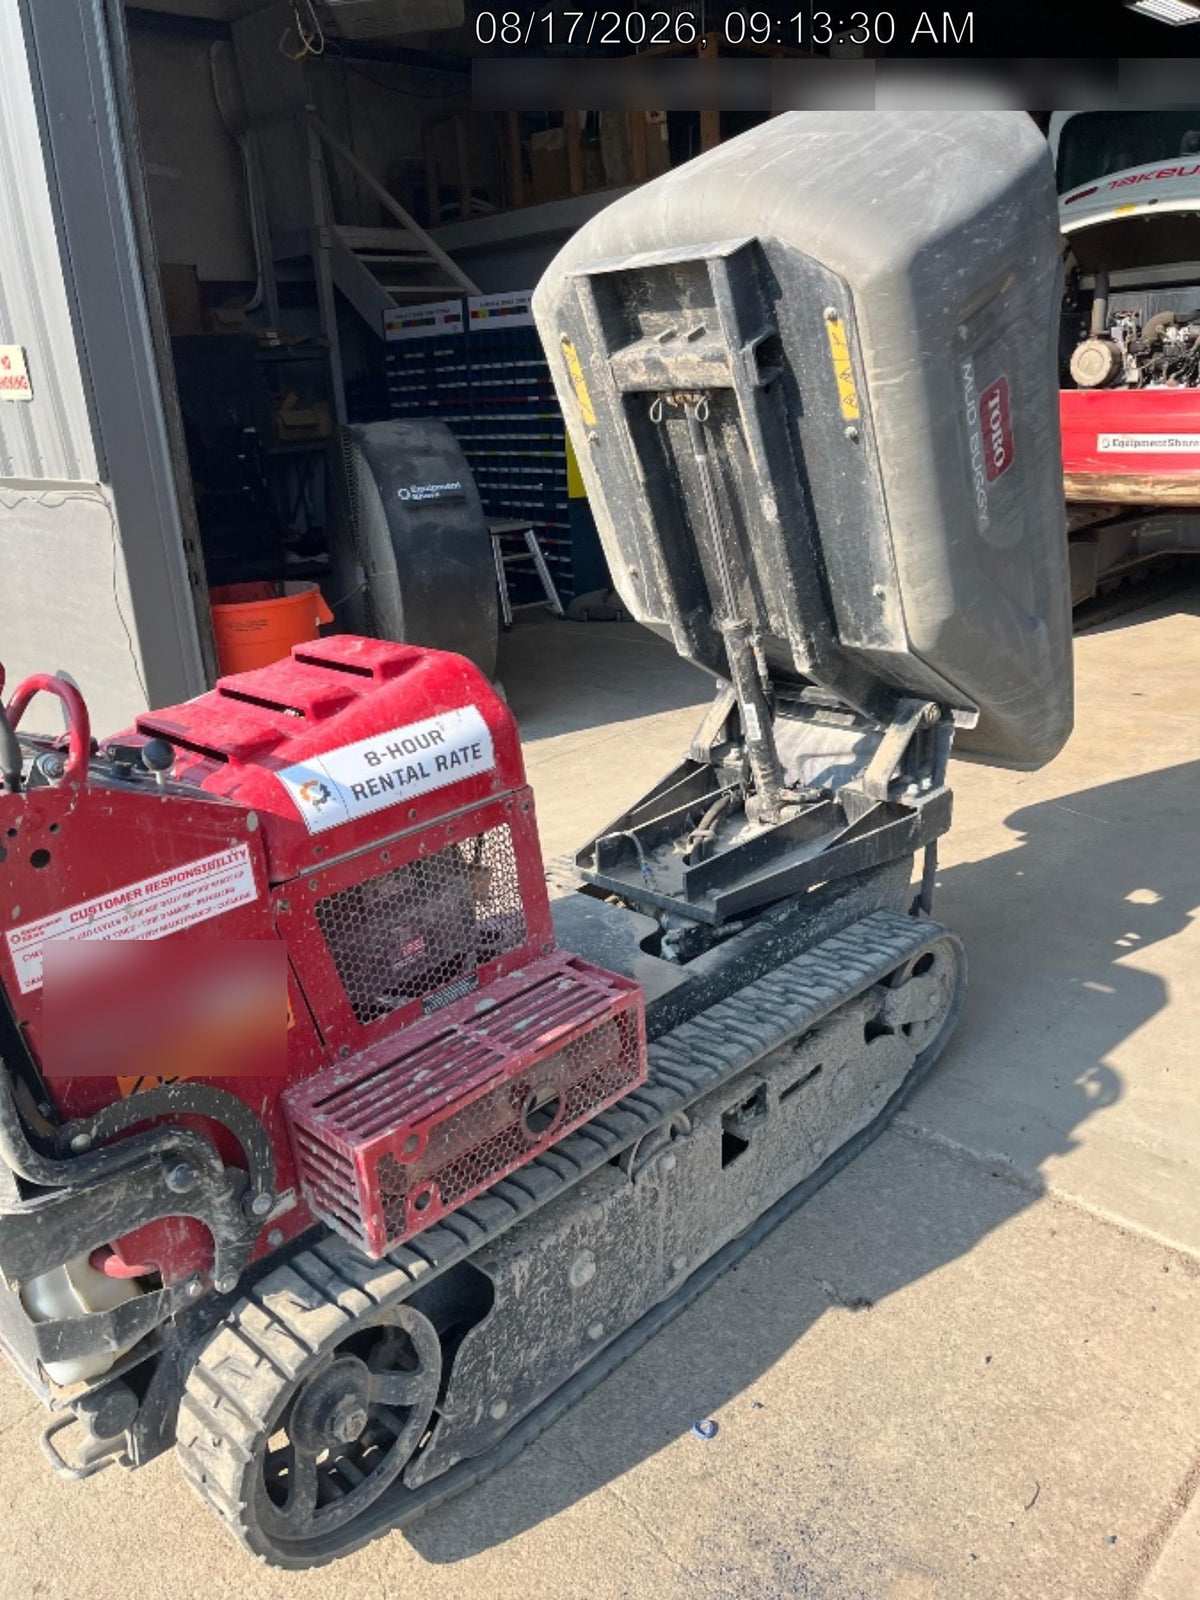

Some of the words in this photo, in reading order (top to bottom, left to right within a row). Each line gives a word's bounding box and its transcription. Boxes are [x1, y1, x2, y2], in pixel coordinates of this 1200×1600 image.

[962, 364, 977, 426] MUD
[989, 388, 1006, 468] TORO
[970, 432, 990, 522] BUGGY
[350, 762, 431, 801] RENTAL
[435, 742, 483, 772] RATE
[363, 729, 446, 767] 8-HOUR
[70, 888, 143, 923] CUSTOMER
[145, 849, 247, 895] RESPONSIBILITY
